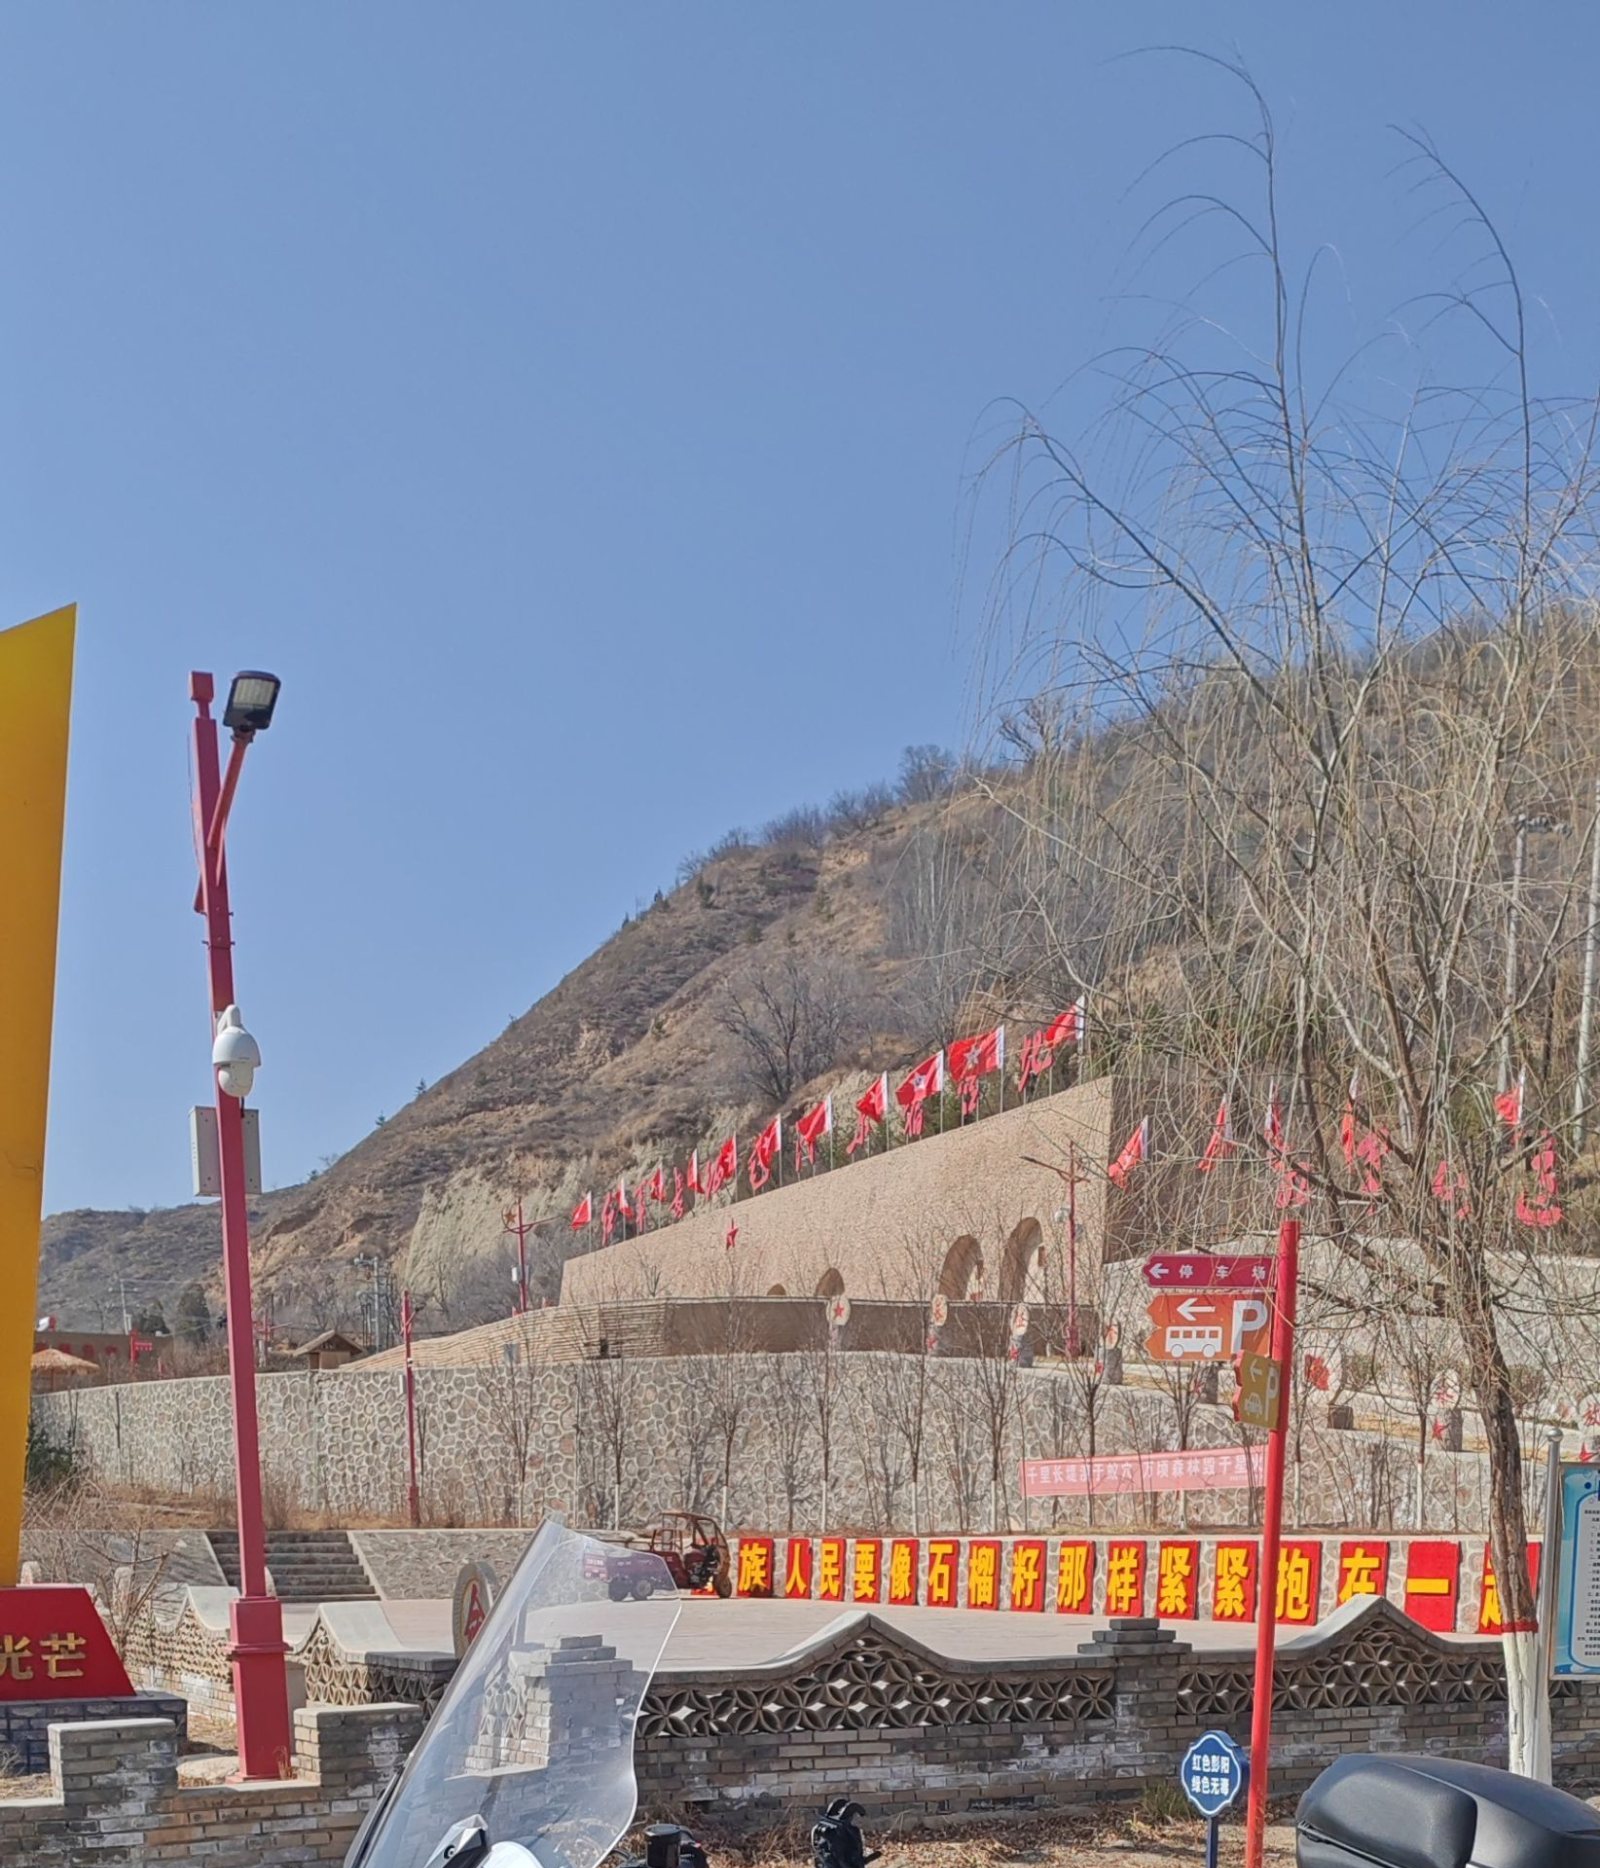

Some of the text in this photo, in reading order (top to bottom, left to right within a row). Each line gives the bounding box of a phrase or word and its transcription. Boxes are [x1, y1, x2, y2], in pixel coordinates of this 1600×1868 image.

[1178, 1263, 1266, 1281] 停车场
[1231, 1300, 1268, 1354] P
